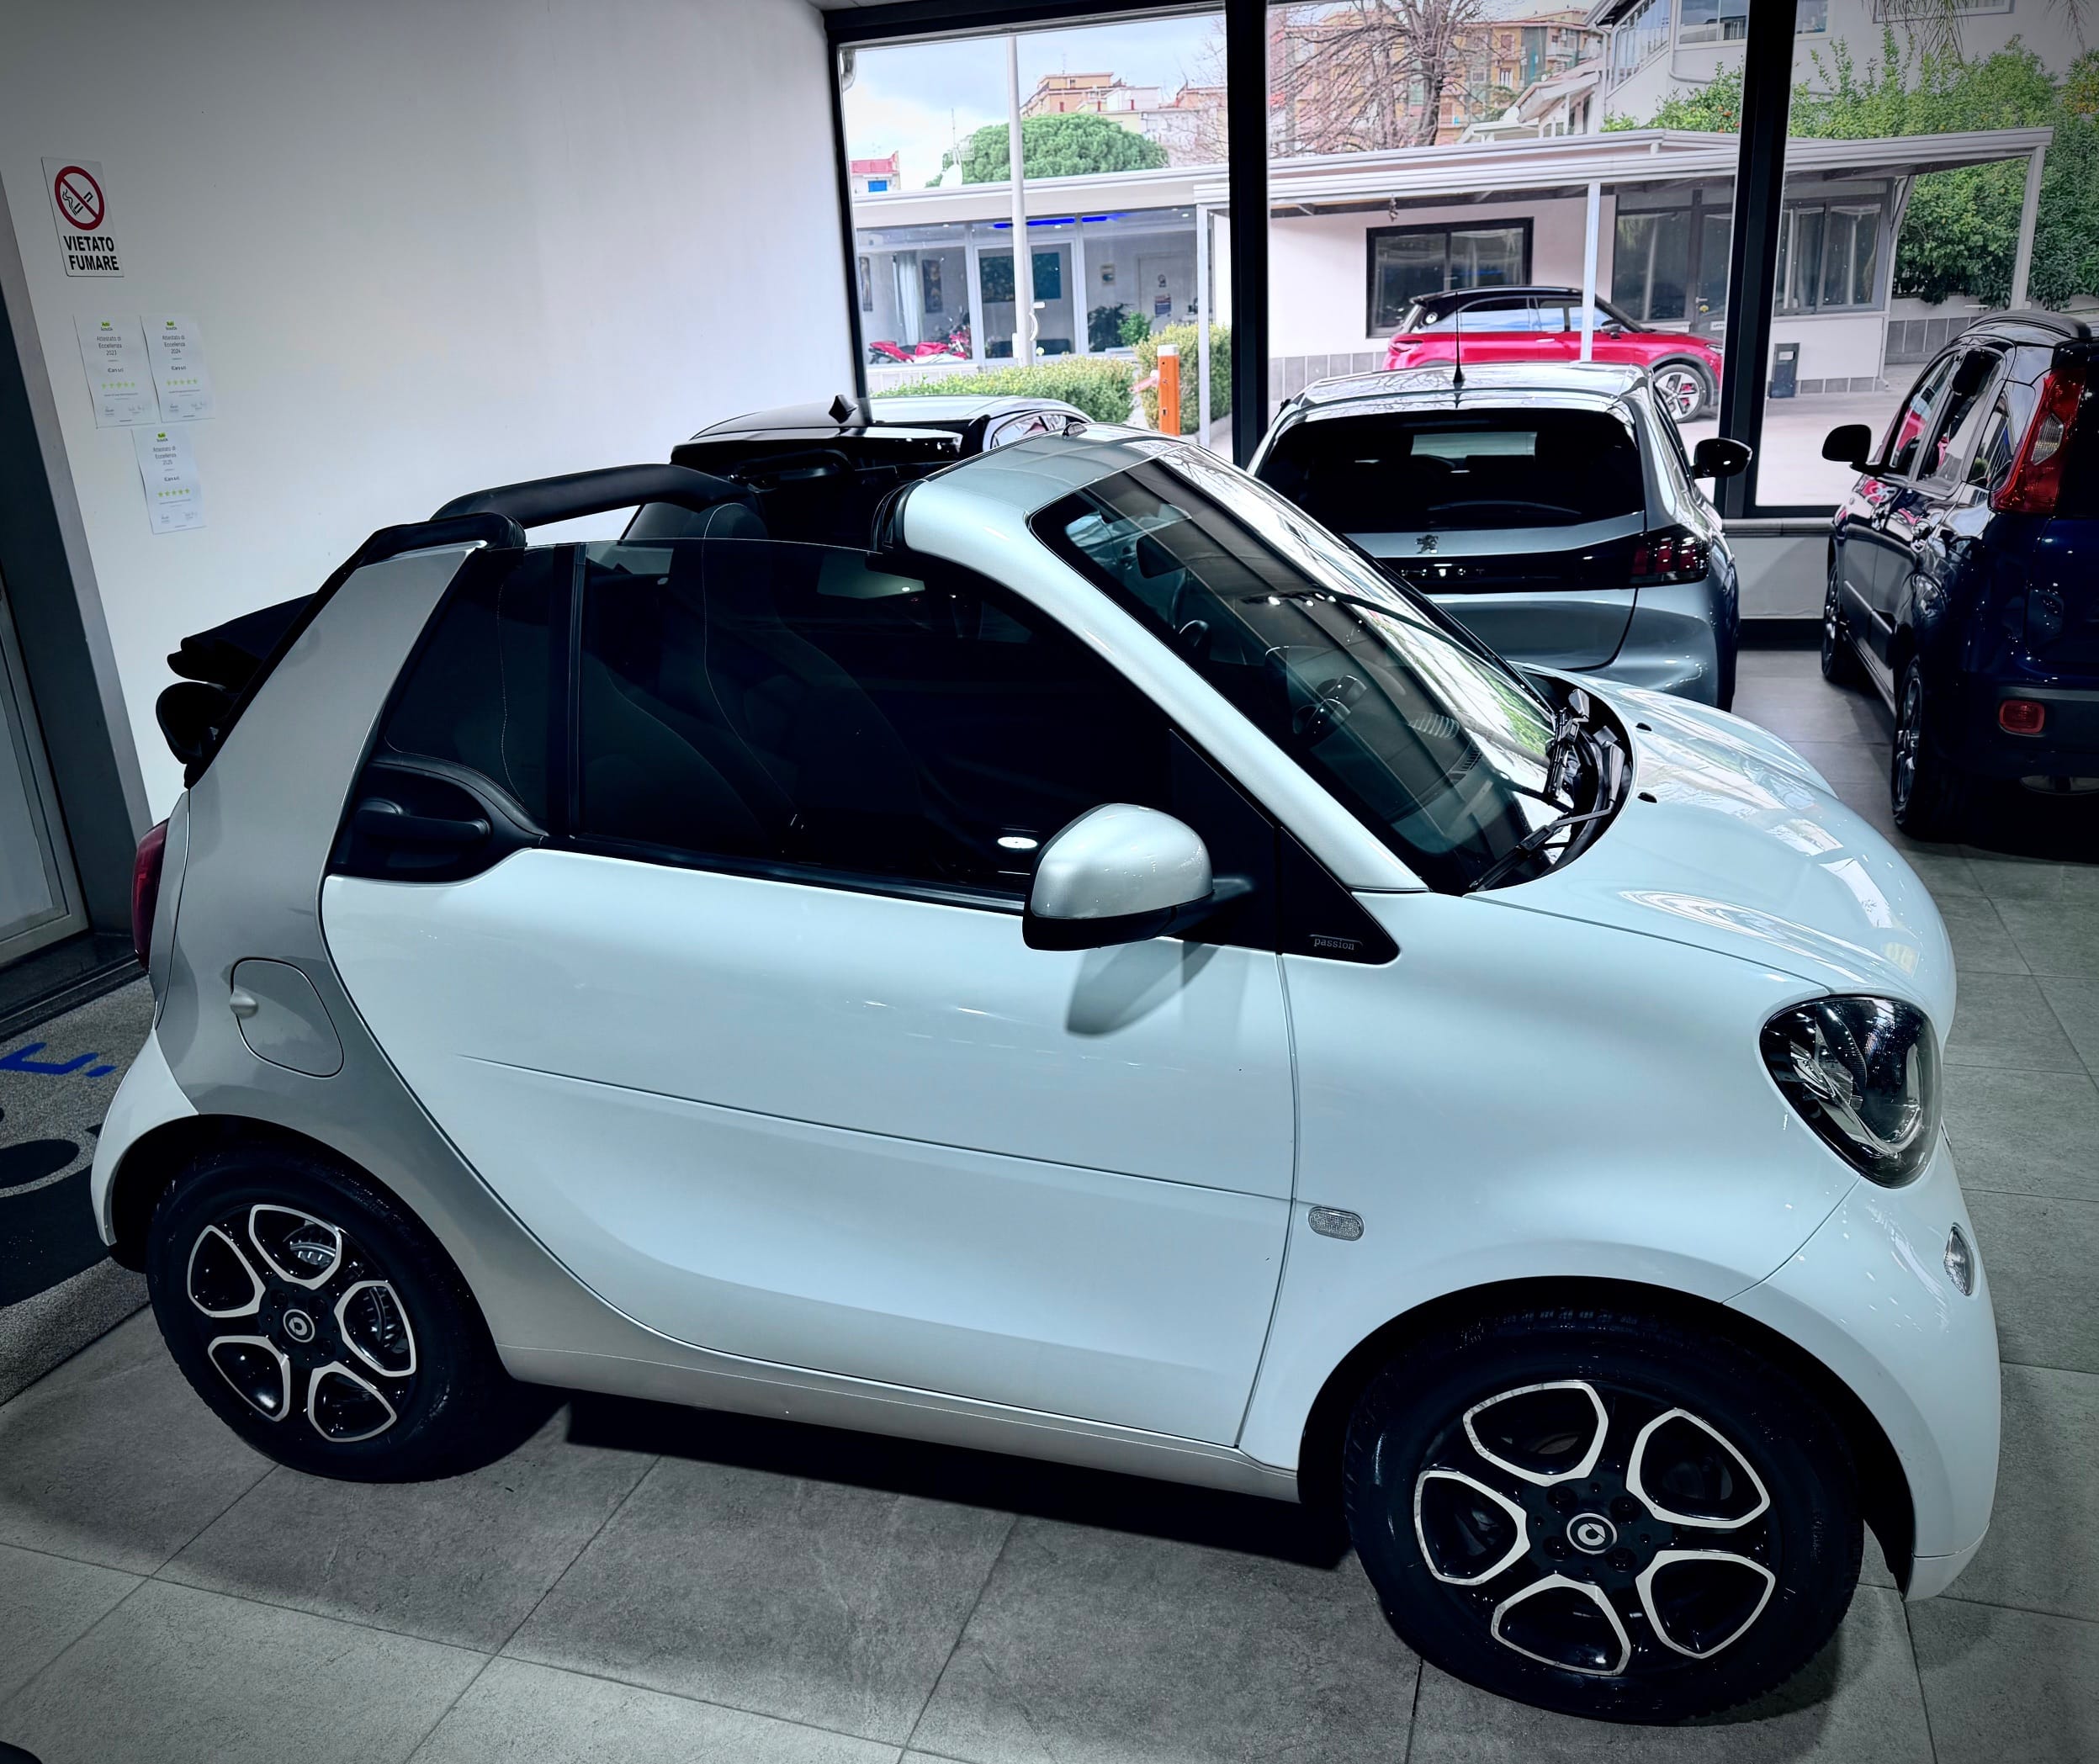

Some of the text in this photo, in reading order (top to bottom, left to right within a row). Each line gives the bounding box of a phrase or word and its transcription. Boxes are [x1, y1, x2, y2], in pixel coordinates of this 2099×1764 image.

[63, 236, 114, 252] VIETATO
[68, 255, 119, 271] FUMARE
[1313, 937, 1354, 950] passion
